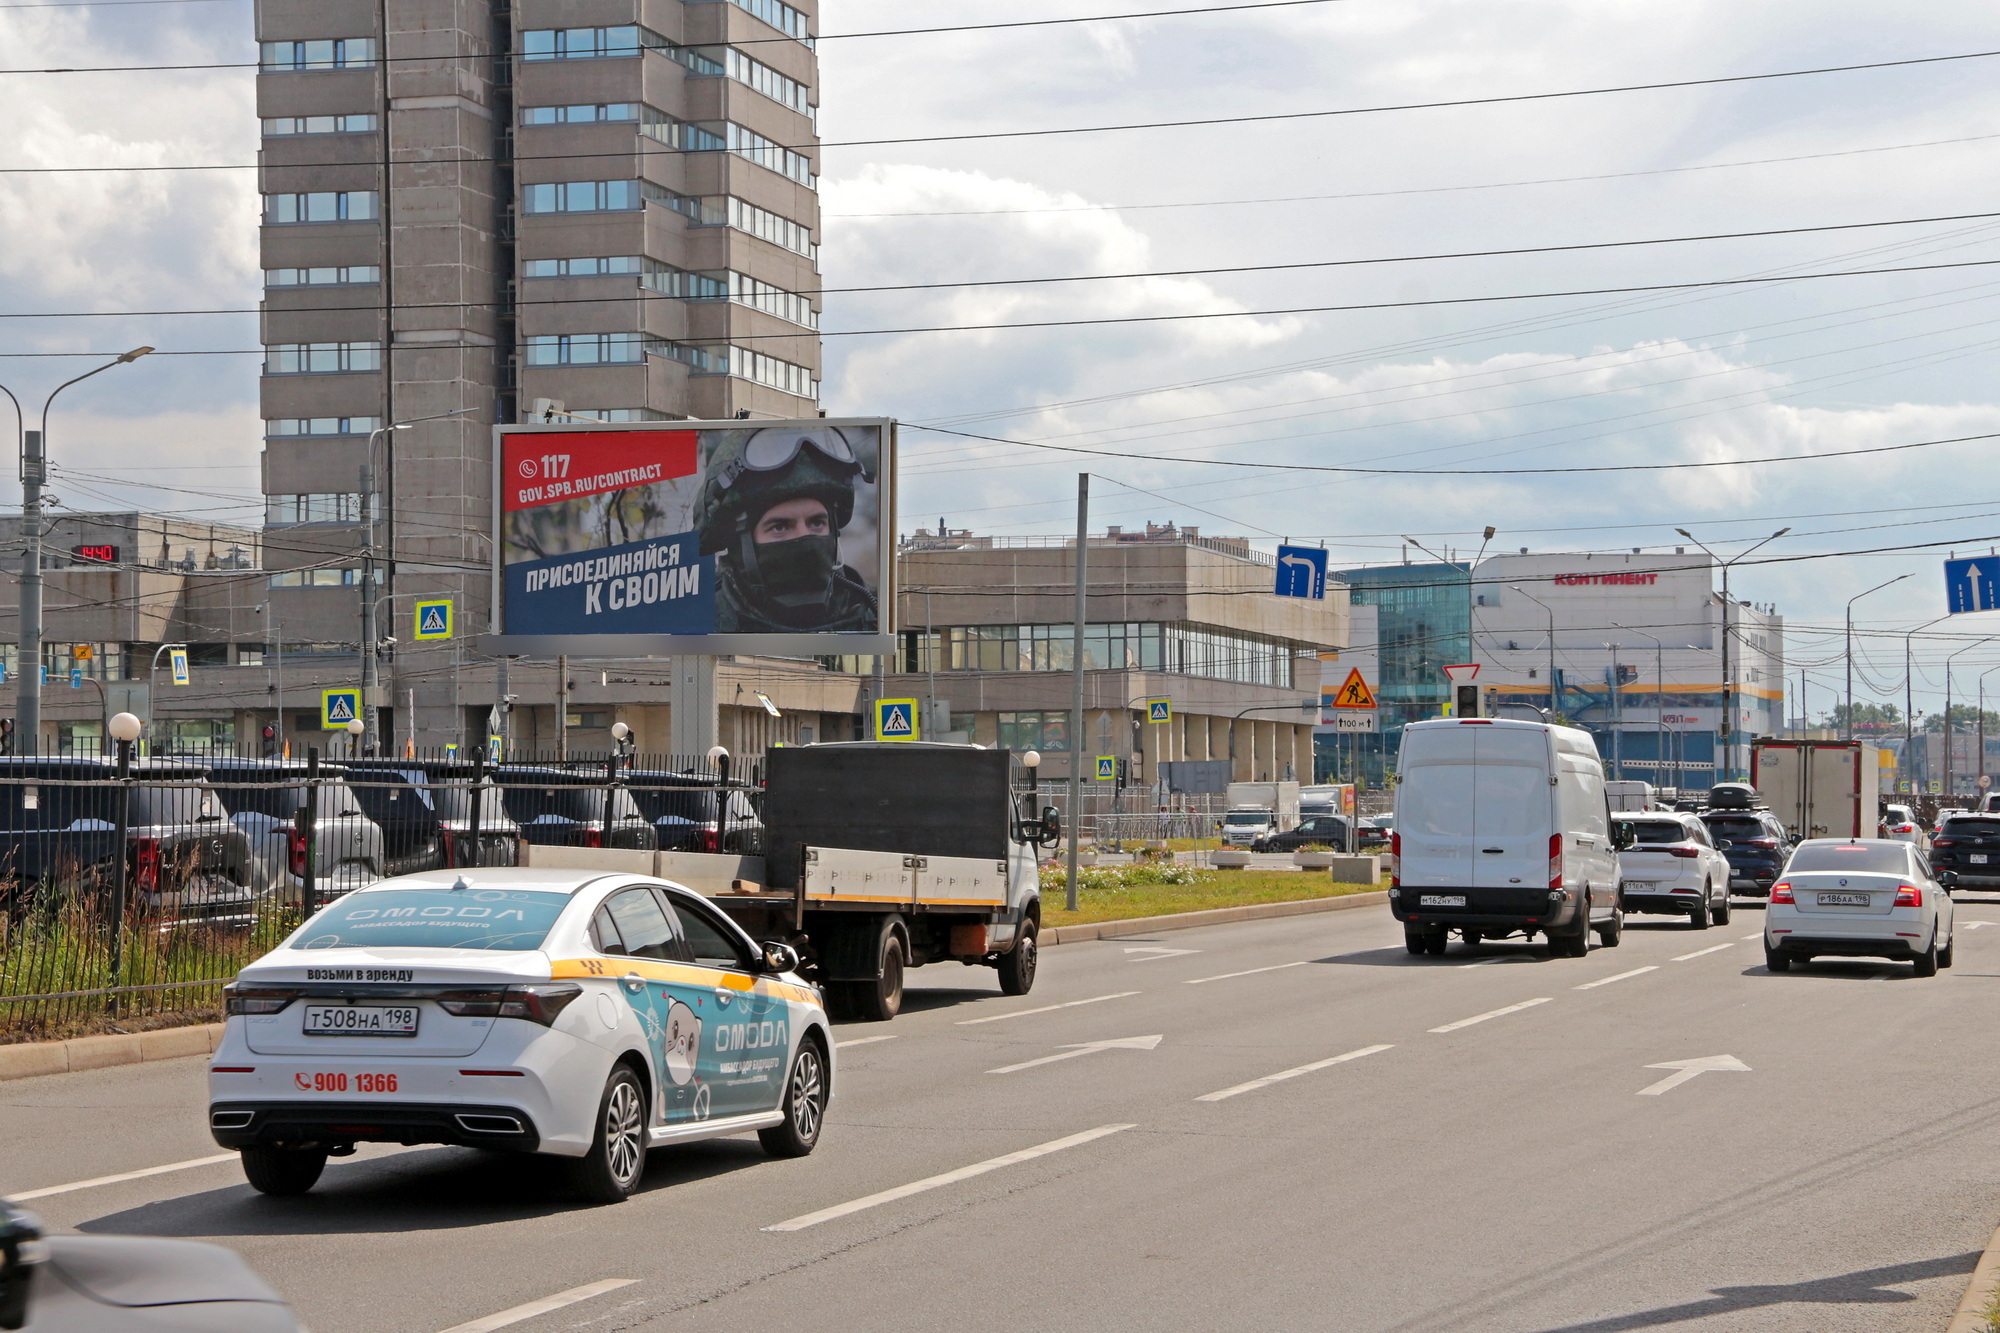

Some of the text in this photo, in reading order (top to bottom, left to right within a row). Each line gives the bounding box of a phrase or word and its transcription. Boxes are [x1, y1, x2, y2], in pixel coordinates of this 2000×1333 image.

[541, 454, 571, 478] 117
[518, 463, 662, 503] GOV.SPB.RU/CONTRACT
[526, 543, 680, 593] ПРИСОЕДИНЯЙСЯ
[585, 563, 700, 615] К СВОИМ
[1554, 573, 1659, 586] КОНТИНЕНТ
[1343, 719, 1357, 728] 100
[1820, 894, 1853, 903] Р186АА
[345, 906, 524, 921] OMODA
[350, 920, 490, 930] АМБАССАДОР БУДУЩЕГО
[307, 969, 413, 982] возьми в аренду
[311, 1009, 413, 1028] Т508НА 198
[715, 1020, 788, 1052] OMODA
[314, 1072, 398, 1093] 900 1366
